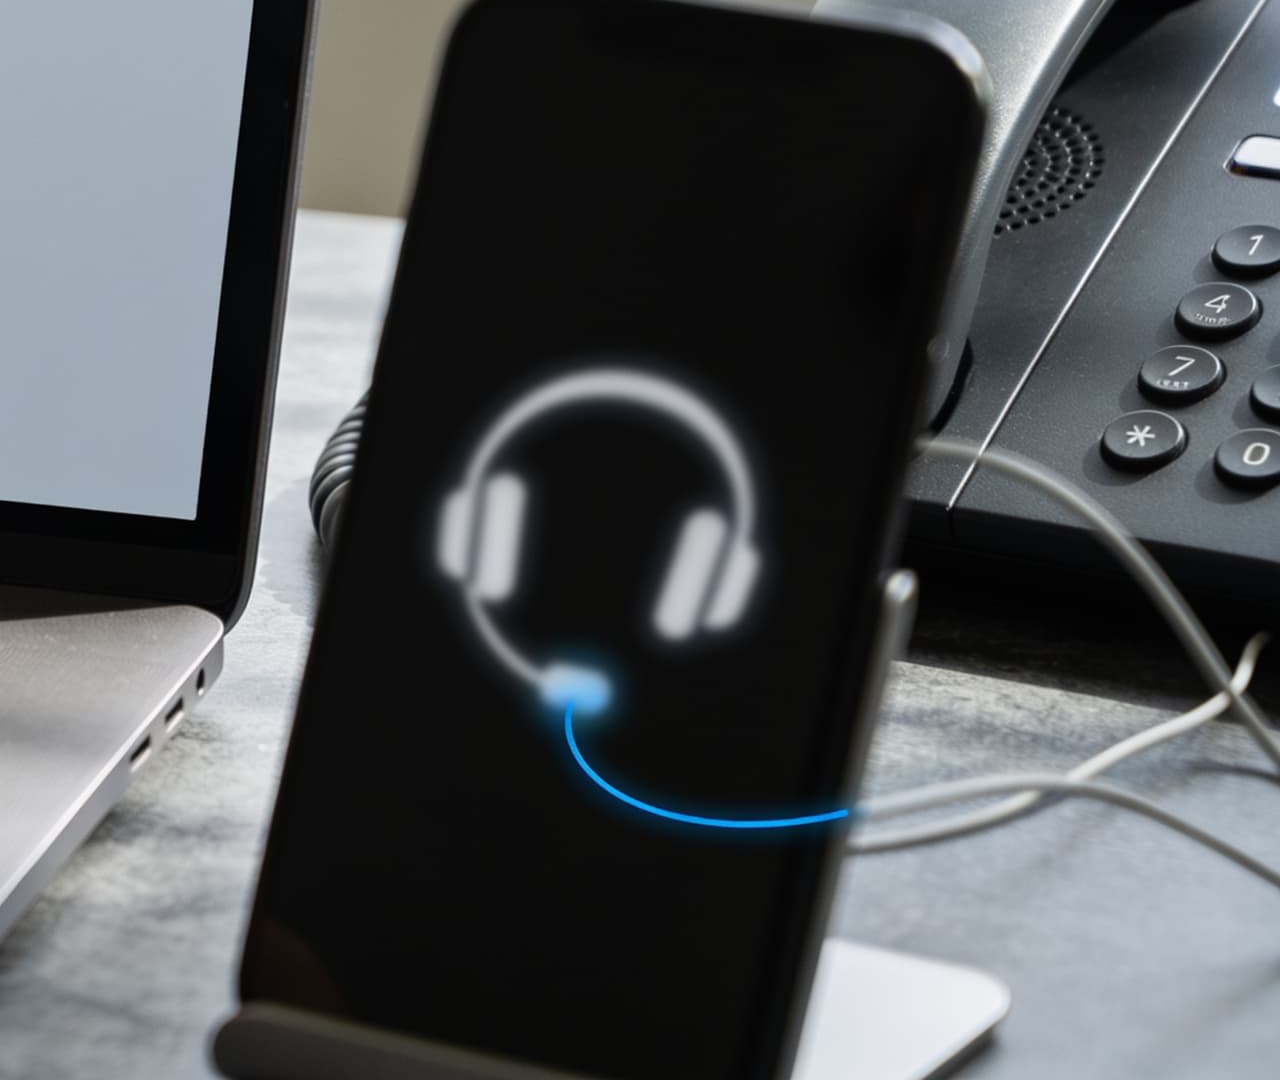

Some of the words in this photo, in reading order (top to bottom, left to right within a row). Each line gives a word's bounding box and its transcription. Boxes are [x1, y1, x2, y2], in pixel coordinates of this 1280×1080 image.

[1249, 235, 1263, 255] 1
[1204, 294, 1231, 314] 4
[1168, 356, 1195, 376] 7
